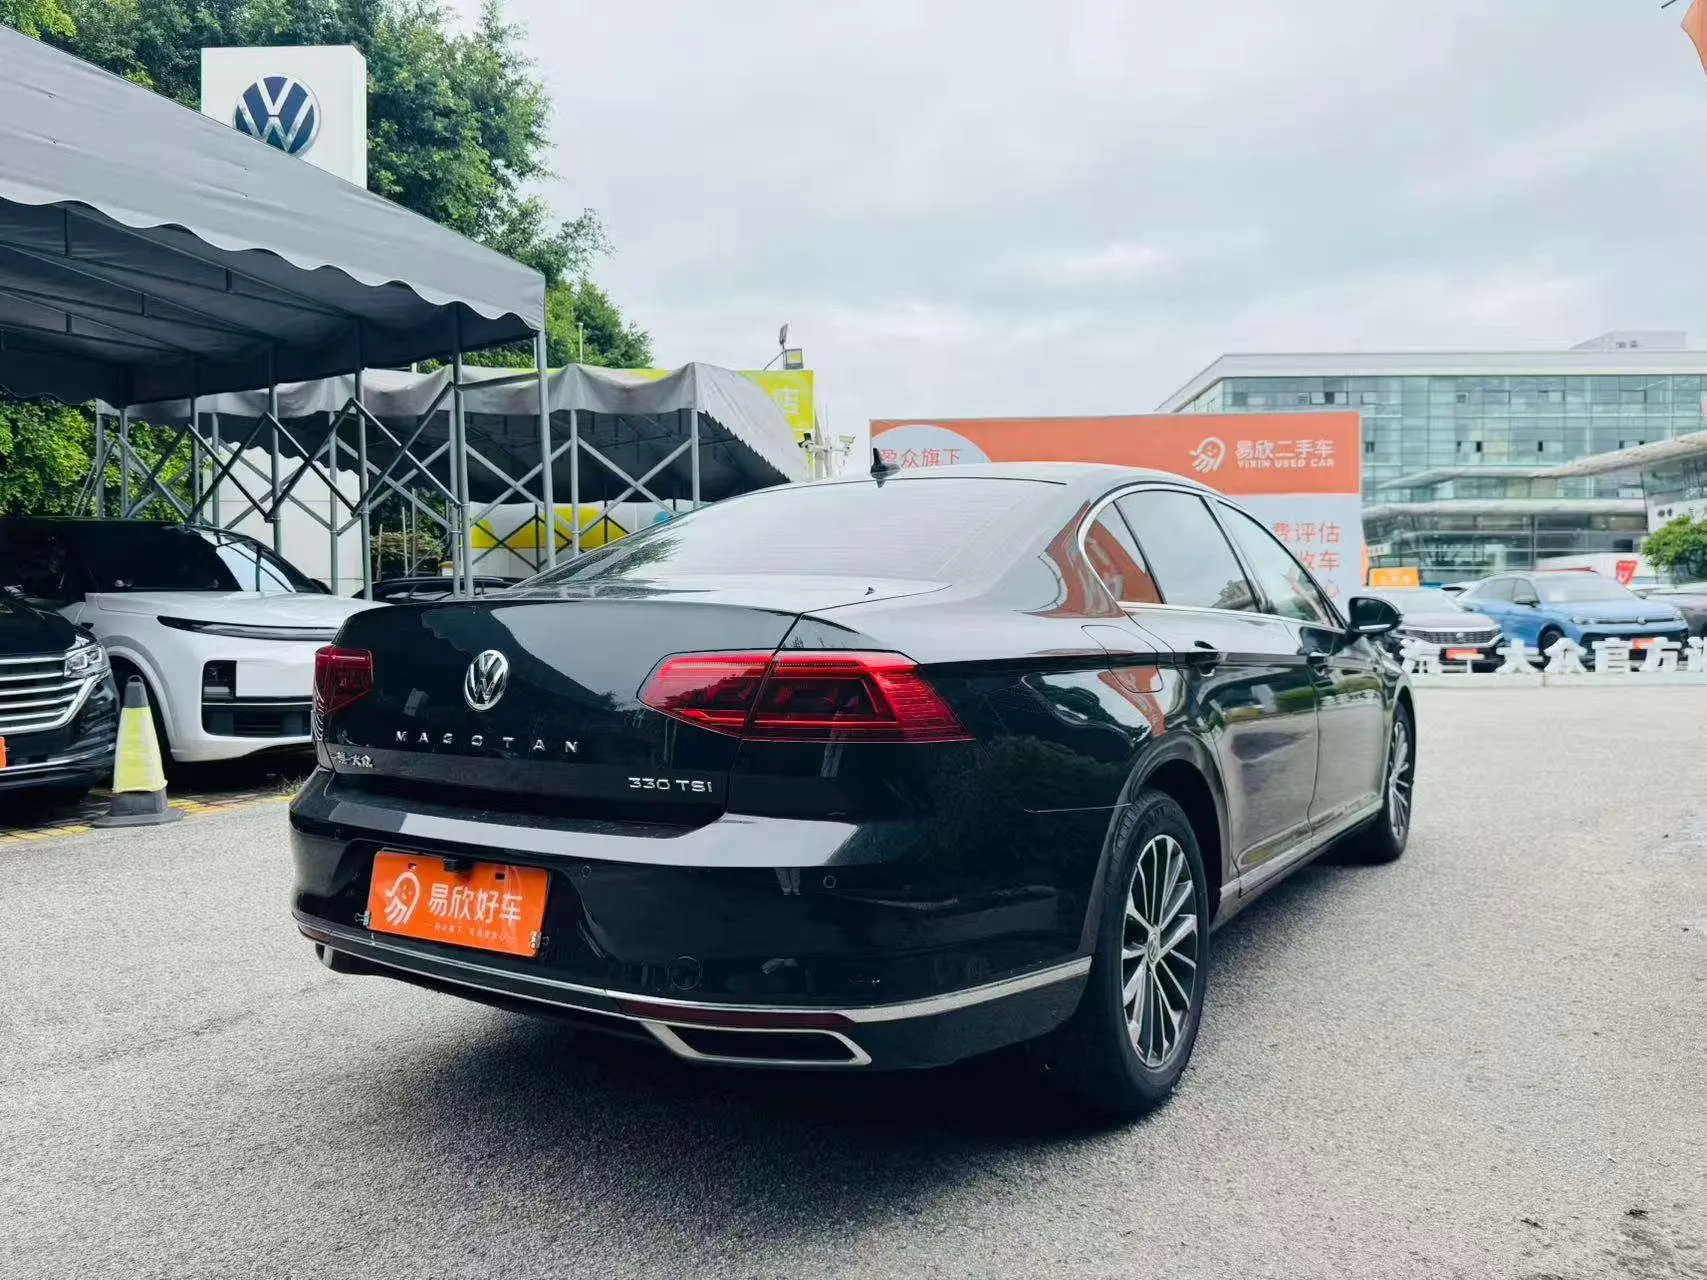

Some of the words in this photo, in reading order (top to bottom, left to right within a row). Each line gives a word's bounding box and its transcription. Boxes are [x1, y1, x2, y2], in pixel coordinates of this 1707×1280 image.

[1236, 440, 1335, 460] 易欣二手车
[1274, 459, 1305, 468] USED
[1310, 459, 1335, 467] CAR
[394, 730, 579, 753] MAGOTAN
[628, 776, 670, 790] 330
[428, 883, 523, 927] 易欣好车
